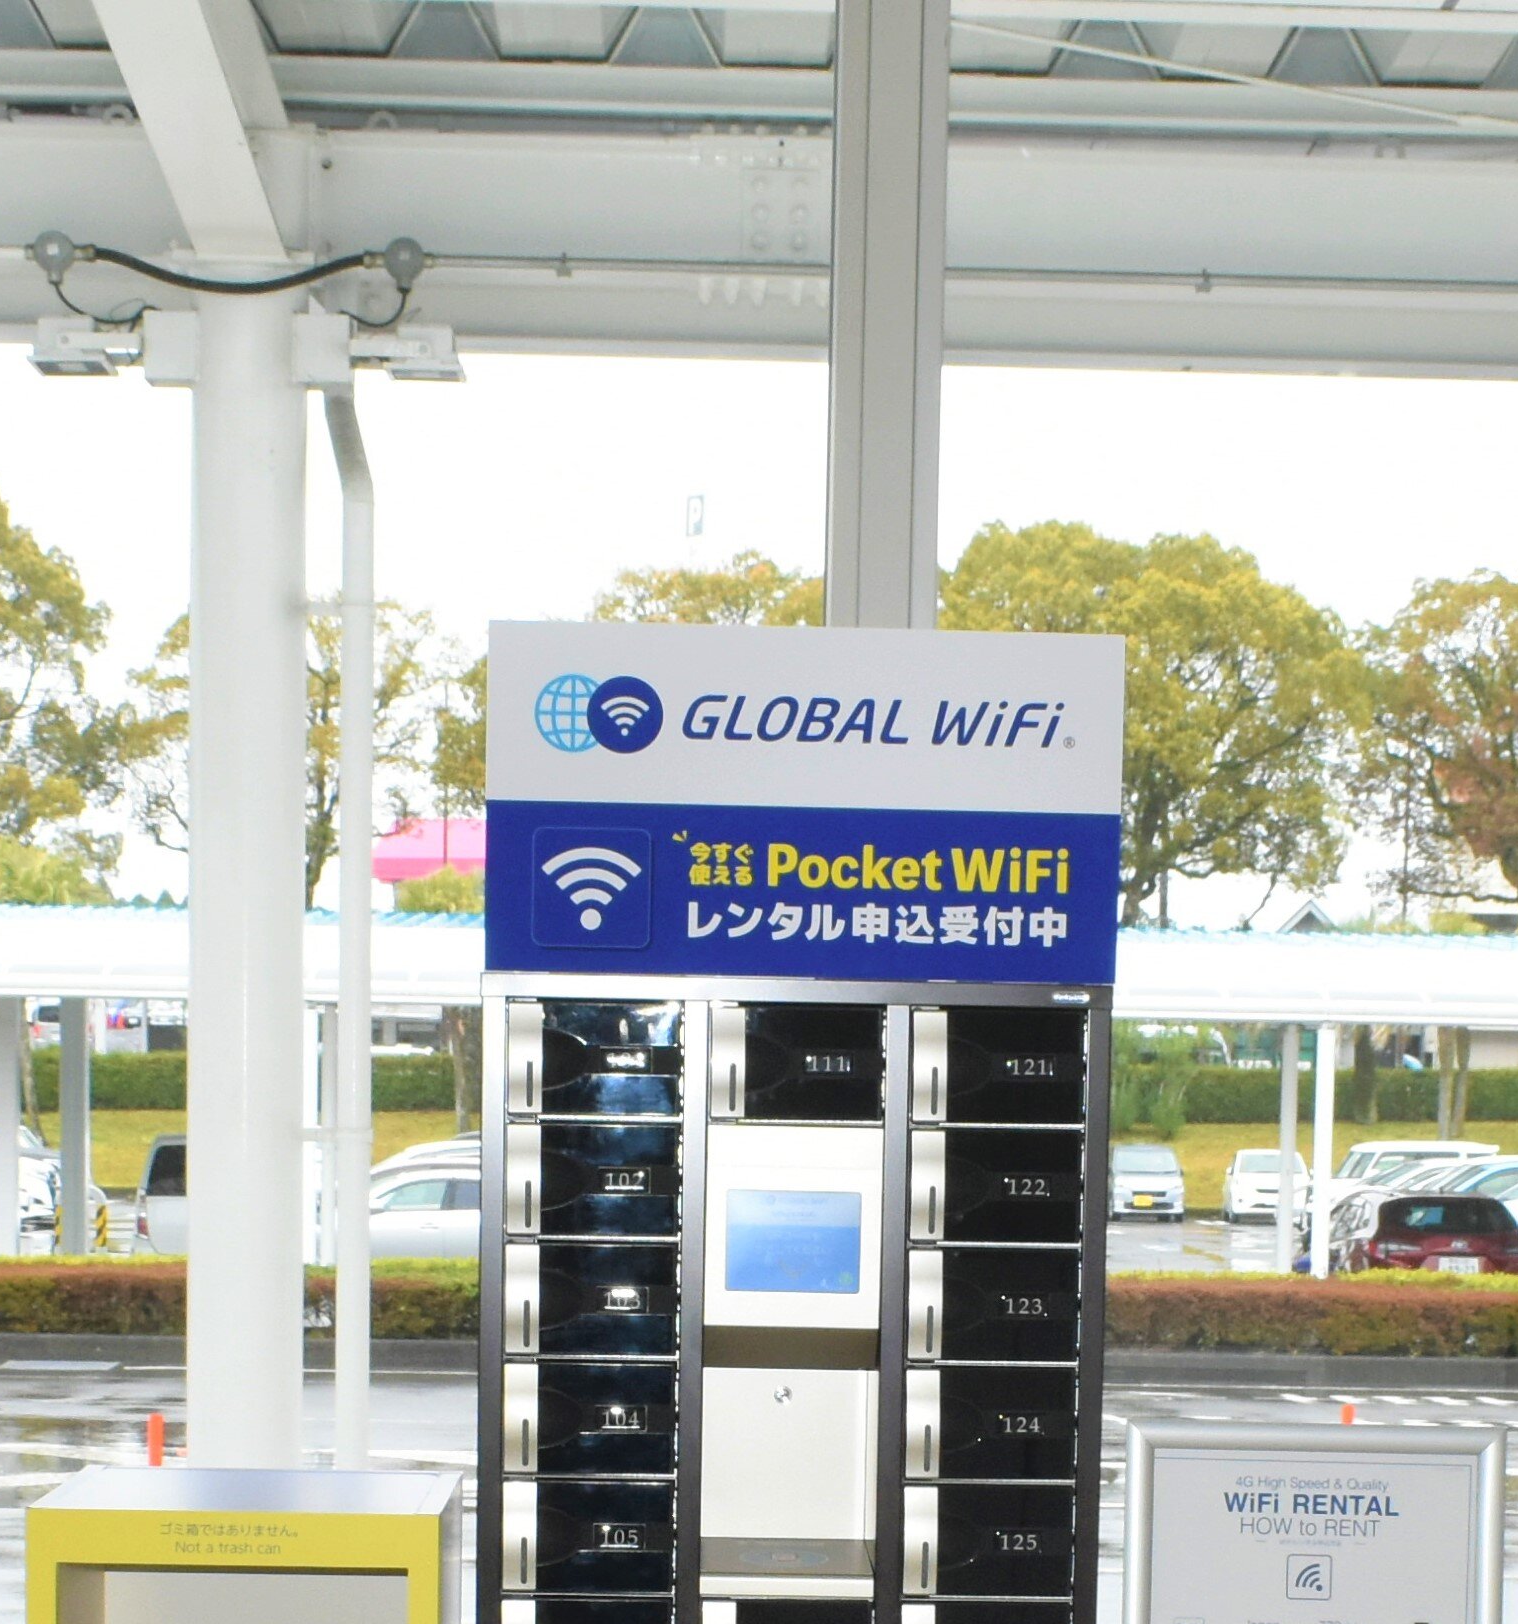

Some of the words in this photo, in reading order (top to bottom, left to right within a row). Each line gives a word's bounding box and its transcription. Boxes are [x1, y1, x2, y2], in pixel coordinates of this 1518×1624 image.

[683, 694, 909, 746] GLOBAL
[689, 842, 753, 864] 今すぐ
[689, 864, 753, 886] 使える
[767, 843, 942, 891] Pocket
[951, 847, 1069, 894] WiFi
[688, 901, 1067, 947] レンタル申込受付中
[807, 1055, 848, 1072] 111
[1009, 1058, 1049, 1076] 121
[1007, 1178, 1046, 1196] 122
[1003, 1298, 1043, 1315] 123
[601, 1409, 640, 1428] 104
[1001, 1416, 1041, 1434] 124
[1235, 1476, 1253, 1488] 4G
[1258, 1477, 1286, 1491] High
[1290, 1477, 1330, 1491] Speed
[1333, 1479, 1342, 1489] &
[1347, 1479, 1389, 1492] Quality
[1224, 1492, 1279, 1513] WiFi
[1292, 1494, 1399, 1516] RENTAL
[160, 1522, 299, 1538] ゴミ箱ではありません。
[1240, 1517, 1293, 1535] HOW
[1299, 1520, 1317, 1536] to
[1324, 1519, 1380, 1537] RENT
[600, 1527, 639, 1547] 105
[998, 1533, 1038, 1551] 125
[175, 1542, 200, 1553] Not
[206, 1544, 214, 1554] a
[219, 1542, 253, 1554] trash
[258, 1545, 281, 1555] can
